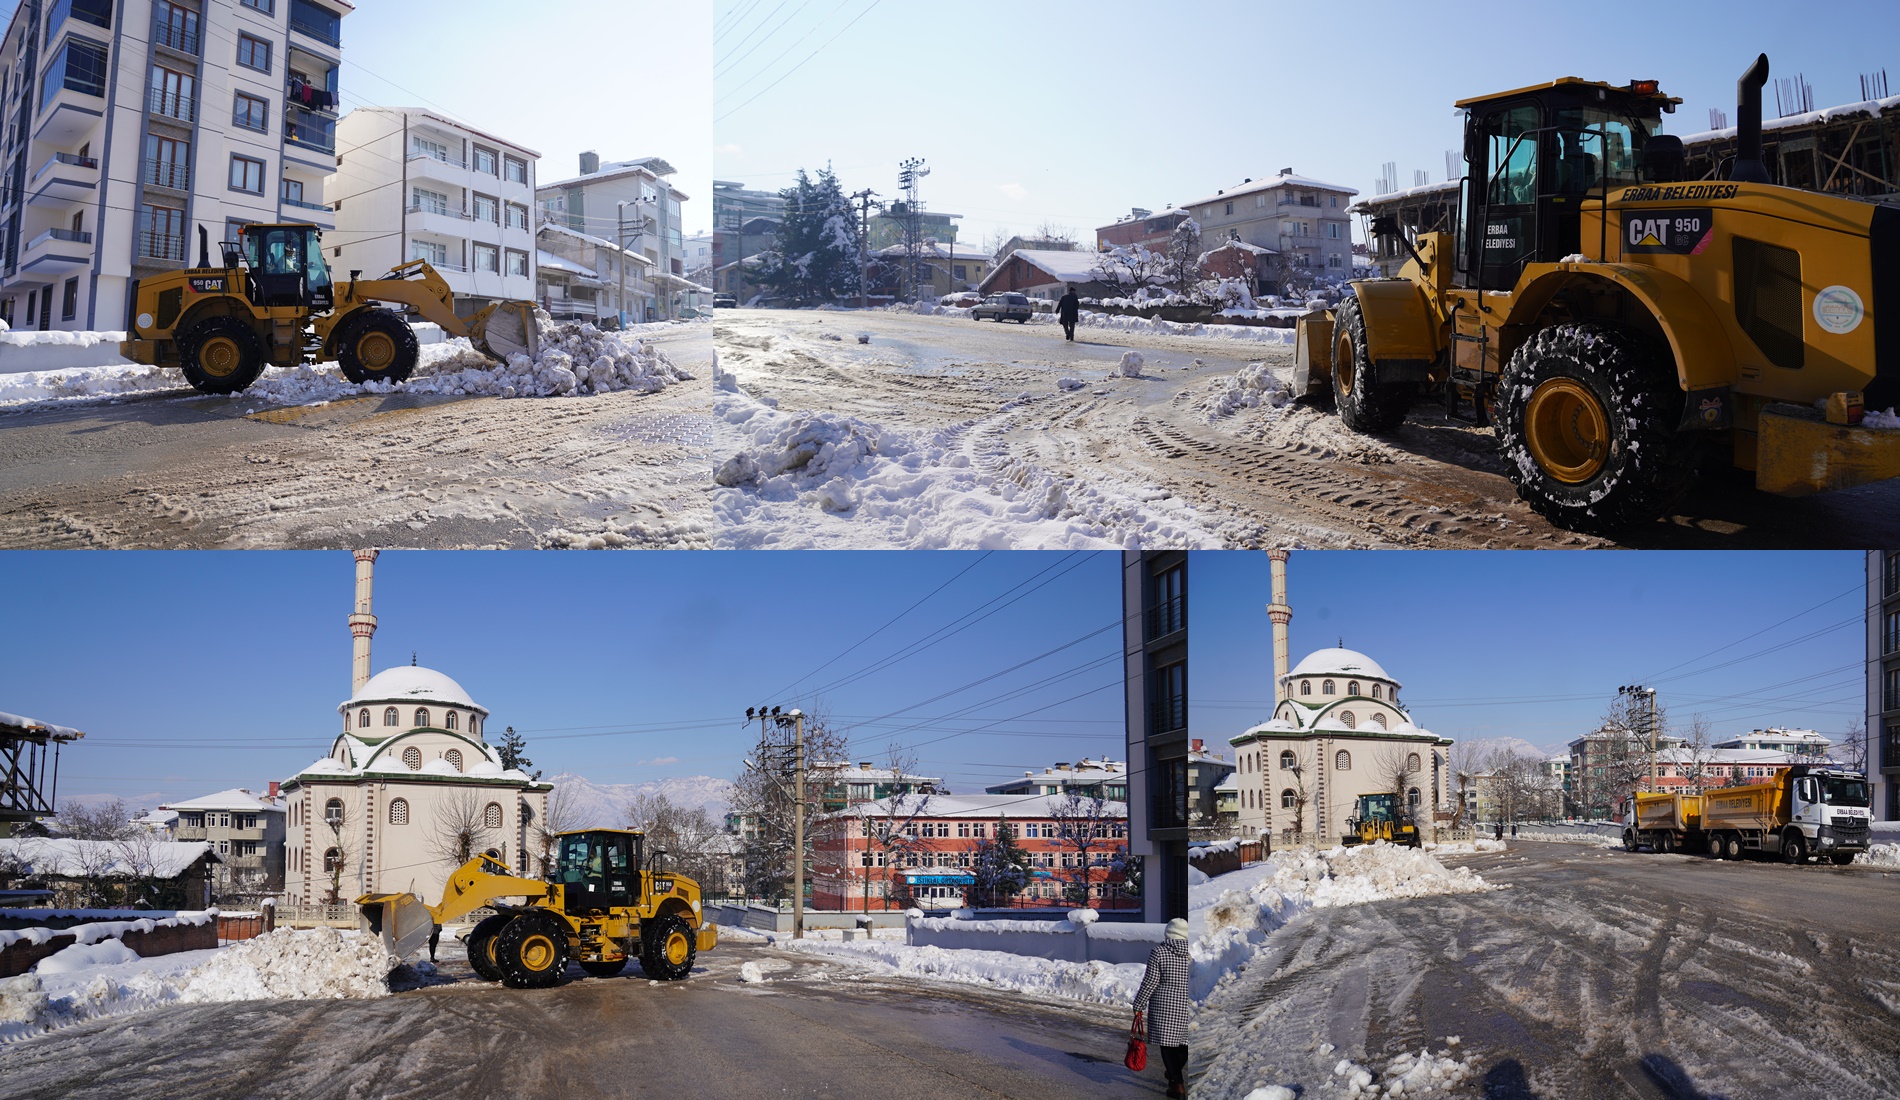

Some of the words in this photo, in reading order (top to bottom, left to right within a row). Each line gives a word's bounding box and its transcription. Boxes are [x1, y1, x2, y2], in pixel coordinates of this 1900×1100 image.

[1621, 187, 1662, 201] ERBAA
[1662, 185, 1739, 200] BELEDİYESİ
[1487, 225, 1508, 235] ERBAA
[1629, 219, 1670, 245] CAT
[1675, 218, 1700, 232] 950
[1482, 239, 1516, 249] ELEDİYESİ
[1675, 235, 1689, 246] GC
[205, 280, 222, 290] CAT
